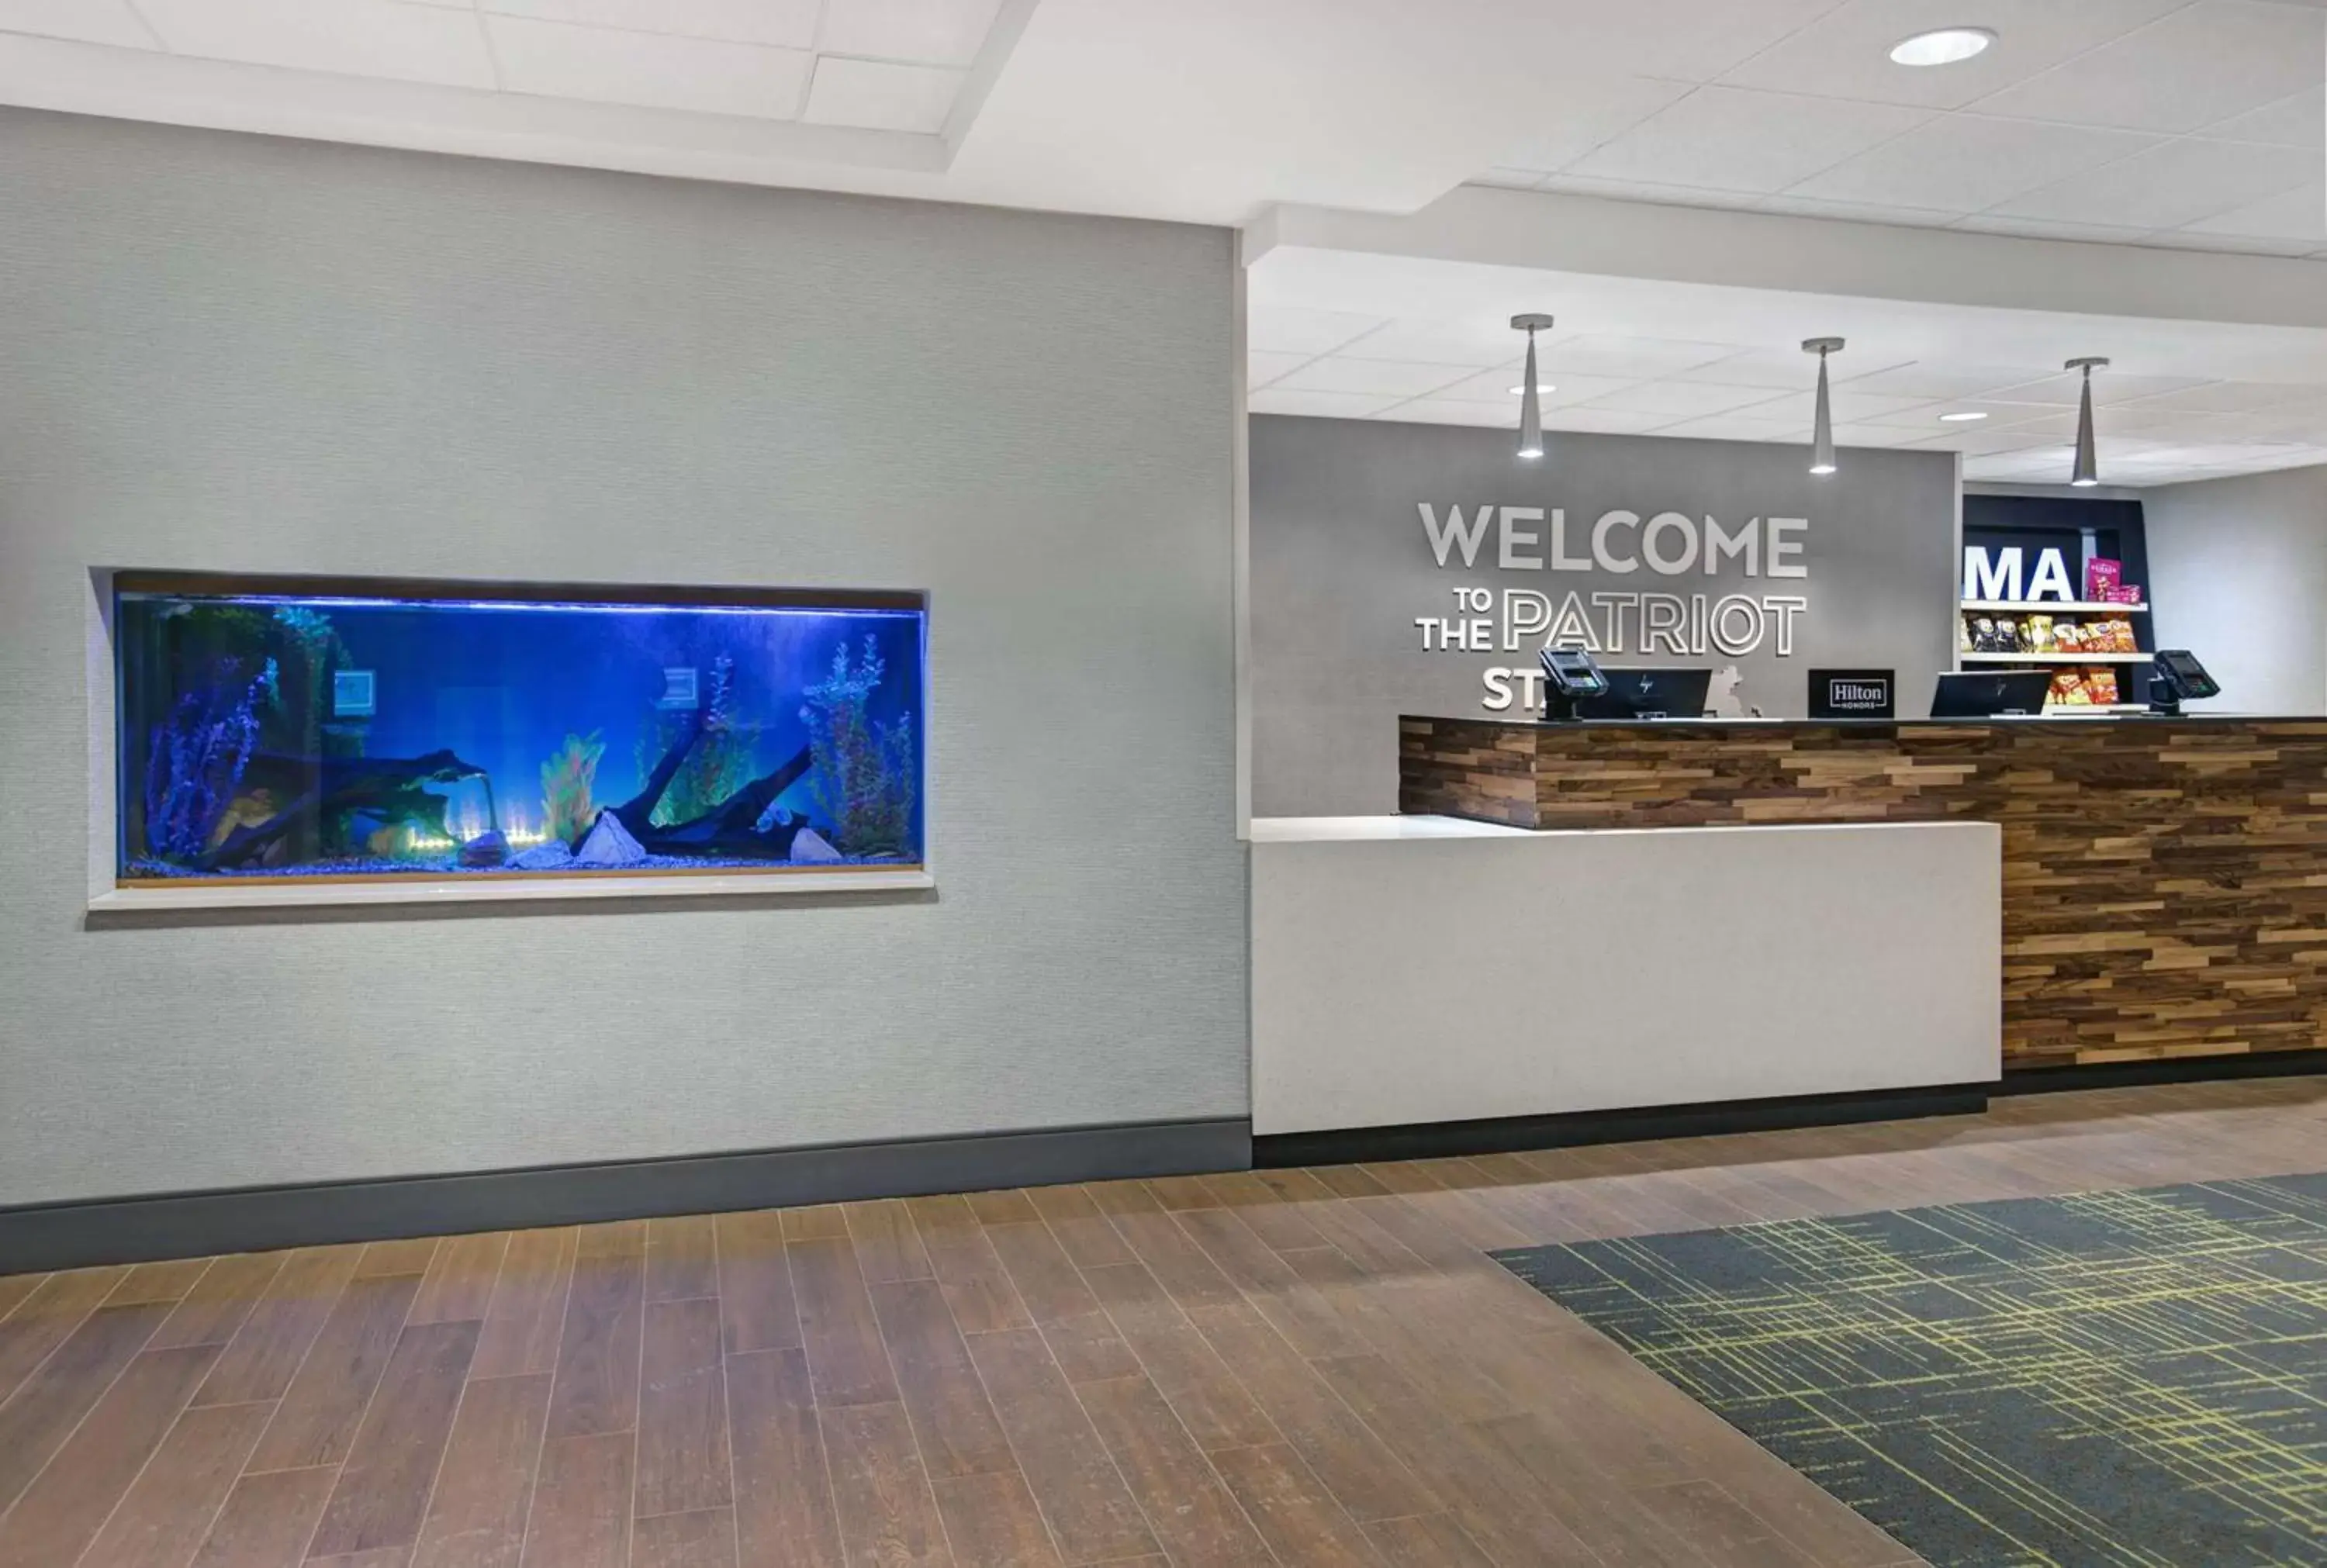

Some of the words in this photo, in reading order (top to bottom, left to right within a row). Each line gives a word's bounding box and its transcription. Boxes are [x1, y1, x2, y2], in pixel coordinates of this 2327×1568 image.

[1418, 503, 1808, 578] WELCOME
[1964, 546, 2075, 601] MA
[1414, 618, 1493, 651] THE
[1502, 589, 1807, 656] PATRIOT
[1452, 587, 1493, 613] TO
[1482, 667, 1547, 710] ST
[1834, 684, 1882, 700] Hilton
